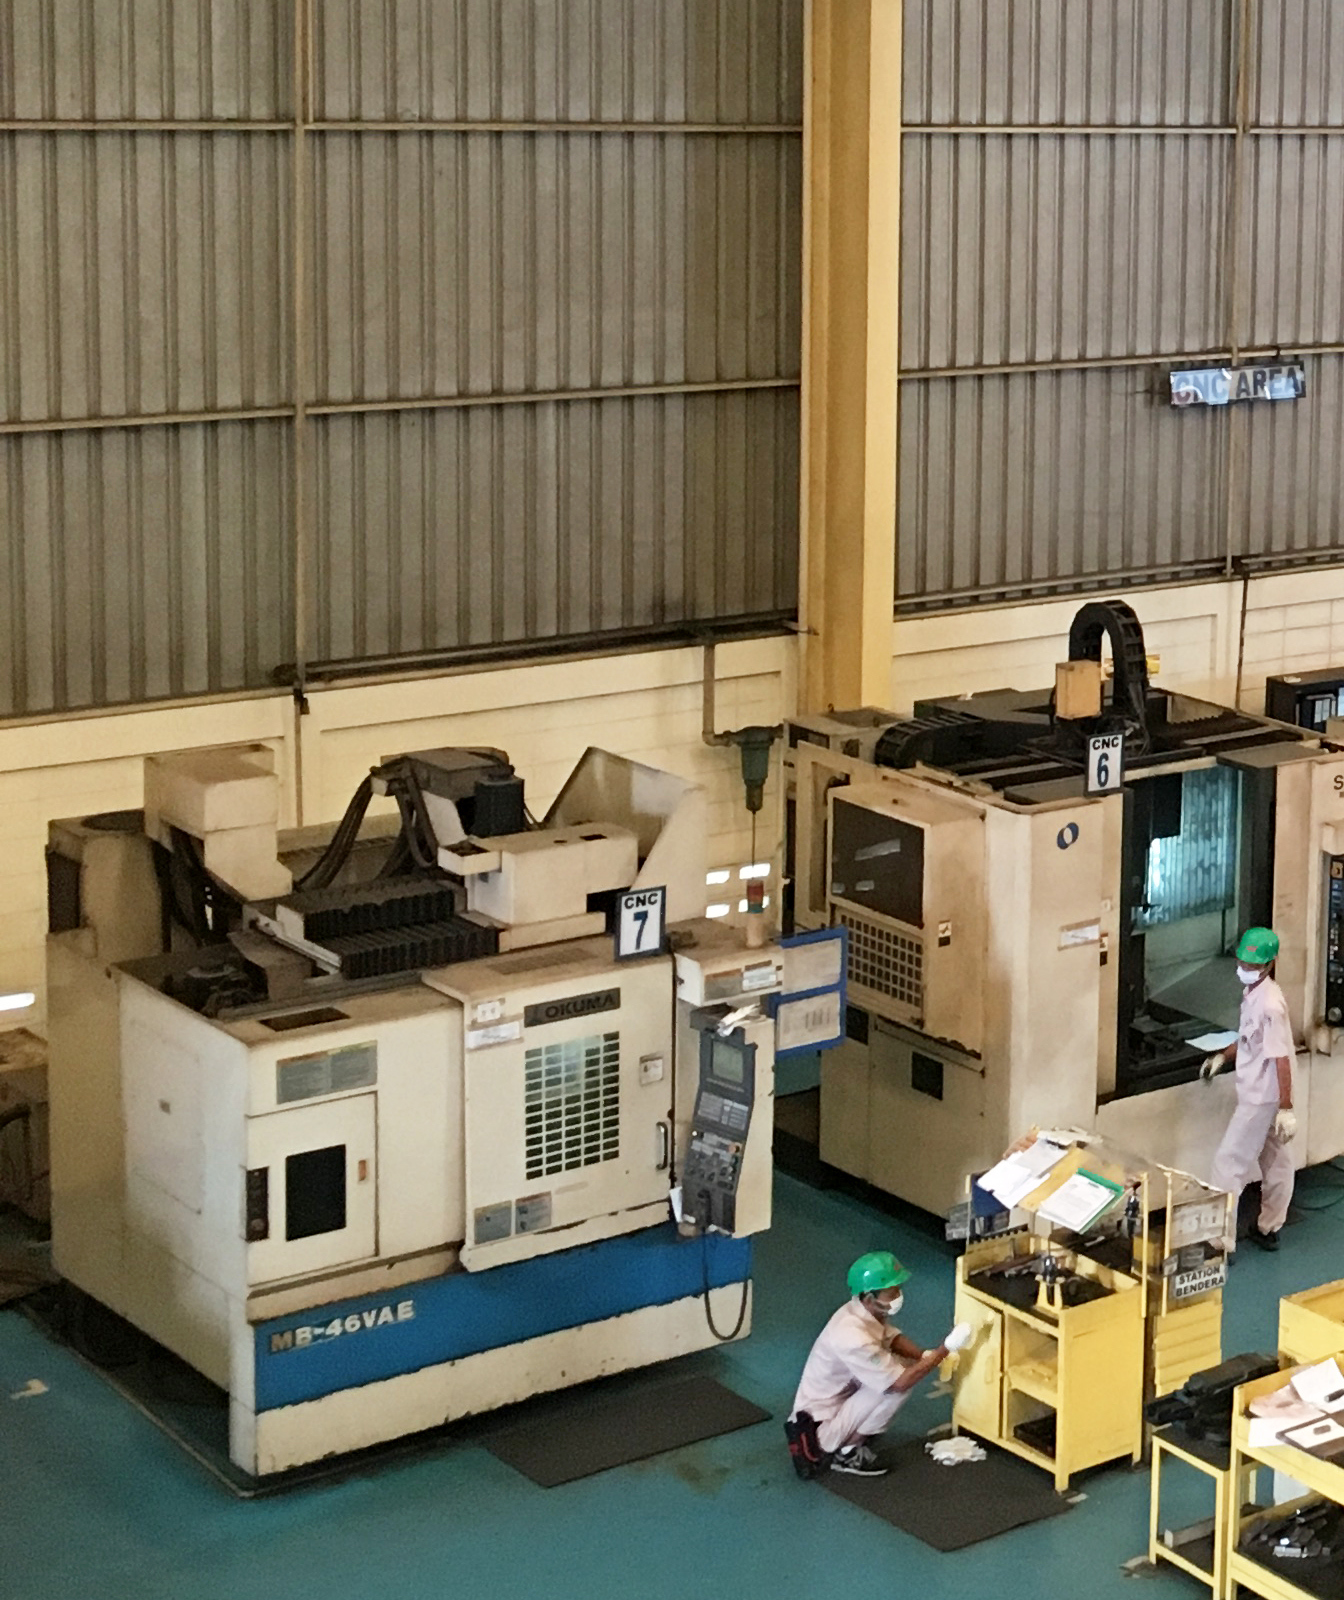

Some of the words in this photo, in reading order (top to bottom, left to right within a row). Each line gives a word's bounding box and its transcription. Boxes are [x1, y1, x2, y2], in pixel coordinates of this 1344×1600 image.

[1175, 371, 1229, 402] CNC
[1236, 367, 1305, 398] AREA
[1092, 736, 1119, 750] CNC
[1097, 752, 1109, 787] 6
[624, 893, 658, 909] CNC
[633, 910, 648, 950] 7
[545, 995, 614, 1019] OKUMA
[1176, 1276, 1224, 1297] BENDERA
[1179, 1266, 1220, 1285] STATION
[271, 1300, 415, 1351] MB-46VAE
